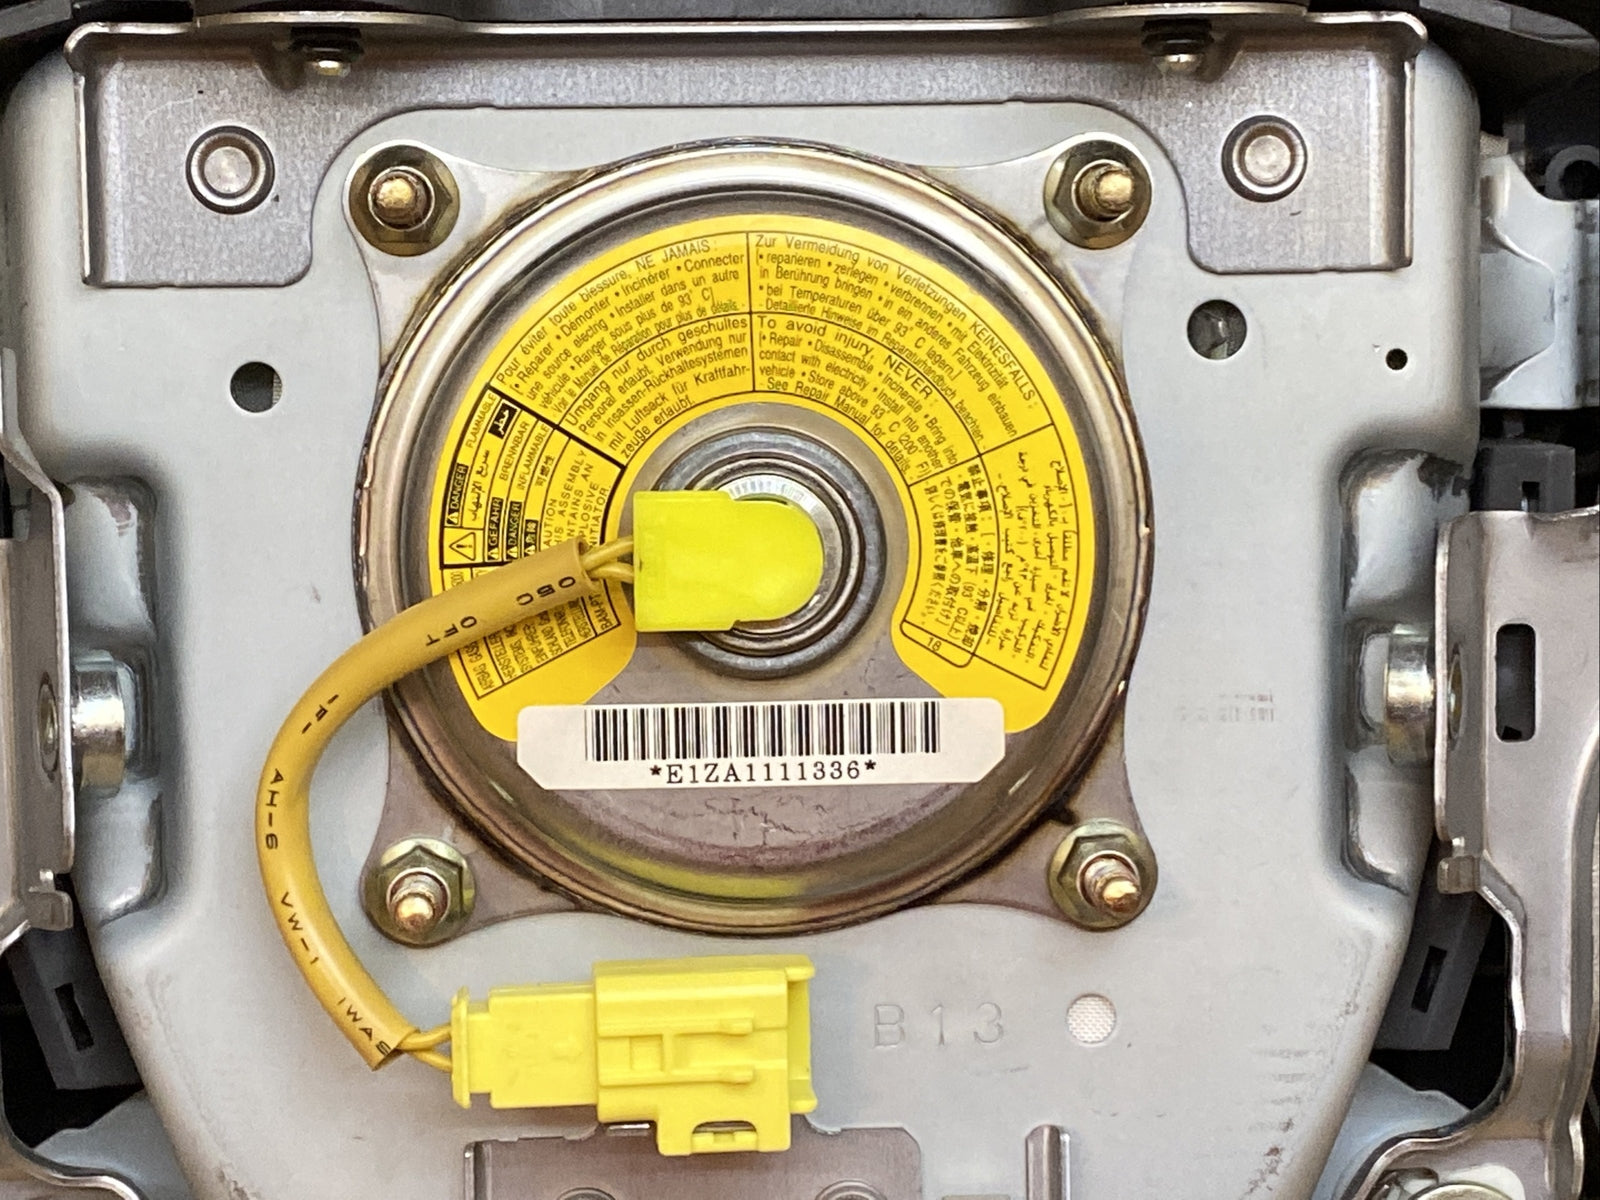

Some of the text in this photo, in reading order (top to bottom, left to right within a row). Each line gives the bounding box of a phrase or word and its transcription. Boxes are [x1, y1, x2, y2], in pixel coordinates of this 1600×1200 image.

[755, 234, 776, 248] Zur
[786, 236, 860, 266] Vermeidung
[867, 257, 889, 273] von
[896, 266, 967, 323] Verletzungen
[790, 285, 862, 314] Temperaturen
[867, 308, 891, 327] über
[496, 357, 521, 385] Pour
[520, 326, 548, 355] éviter
[548, 302, 577, 327] toute
[635, 255, 656, 272] NE
[526, 381, 543, 400] une
[543, 348, 572, 379] source
[660, 280, 687, 297] dans
[692, 275, 706, 287] un
[712, 269, 739, 283] autre
[609, 321, 633, 341] sous
[635, 308, 657, 328] plus
[661, 301, 673, 313] de
[654, 317, 675, 335] pour
[675, 310, 694, 326] plus
[697, 306, 707, 317] de
[757, 315, 777, 329] To
[785, 320, 827, 337] avoid
[834, 332, 874, 360] injury,
[565, 318, 748, 426] Umgang nur durch geschultes
[775, 265, 830, 289] Berührung
[834, 276, 873, 300] bringen
[897, 306, 913, 321] ein
[915, 318, 952, 350] anderes
[952, 347, 990, 392] Fahrzeug
[987, 393, 1017, 437] einbauen
[967, 340, 1009, 390] Elektrizität
[578, 391, 617, 435] Personal
[655, 336, 723, 366] Verwendung
[728, 333, 746, 344] nur
[608, 364, 750, 451] mit Luftsack für Kraftfahr-
[759, 364, 796, 379] vehicle
[839, 385, 868, 408] above
[759, 350, 796, 362] contact
[801, 355, 821, 367] with
[825, 362, 869, 391] electricity
[902, 415, 919, 433] into
[917, 435, 943, 469] another
[794, 380, 830, 404] Repair
[834, 395, 872, 426] Manual
[871, 423, 886, 438] for
[465, 393, 496, 448] FLAMMABLE
[490, 405, 515, 435] خطر
[621, 426, 653, 459] zeuge
[499, 421, 529, 481] BRENNBAR
[517, 424, 549, 490] INFLAMMABLE
[536, 456, 554, 486] 可燃性
[942, 445, 958, 465] into
[449, 465, 467, 510] DANGER
[558, 450, 586, 517] ASSEMBLY
[567, 463, 593, 537] NTAINS AN
[578, 482, 599, 538] PLOSIVE
[489, 497, 503, 545] GEFAHR
[507, 501, 522, 545] DANGER
[543, 498, 557, 547] AUTION
[588, 486, 611, 547] NITIATOR.
[927, 637, 942, 651] 18
[265, 768, 285, 849] AH-6
[281, 891, 319, 965] VW-1
